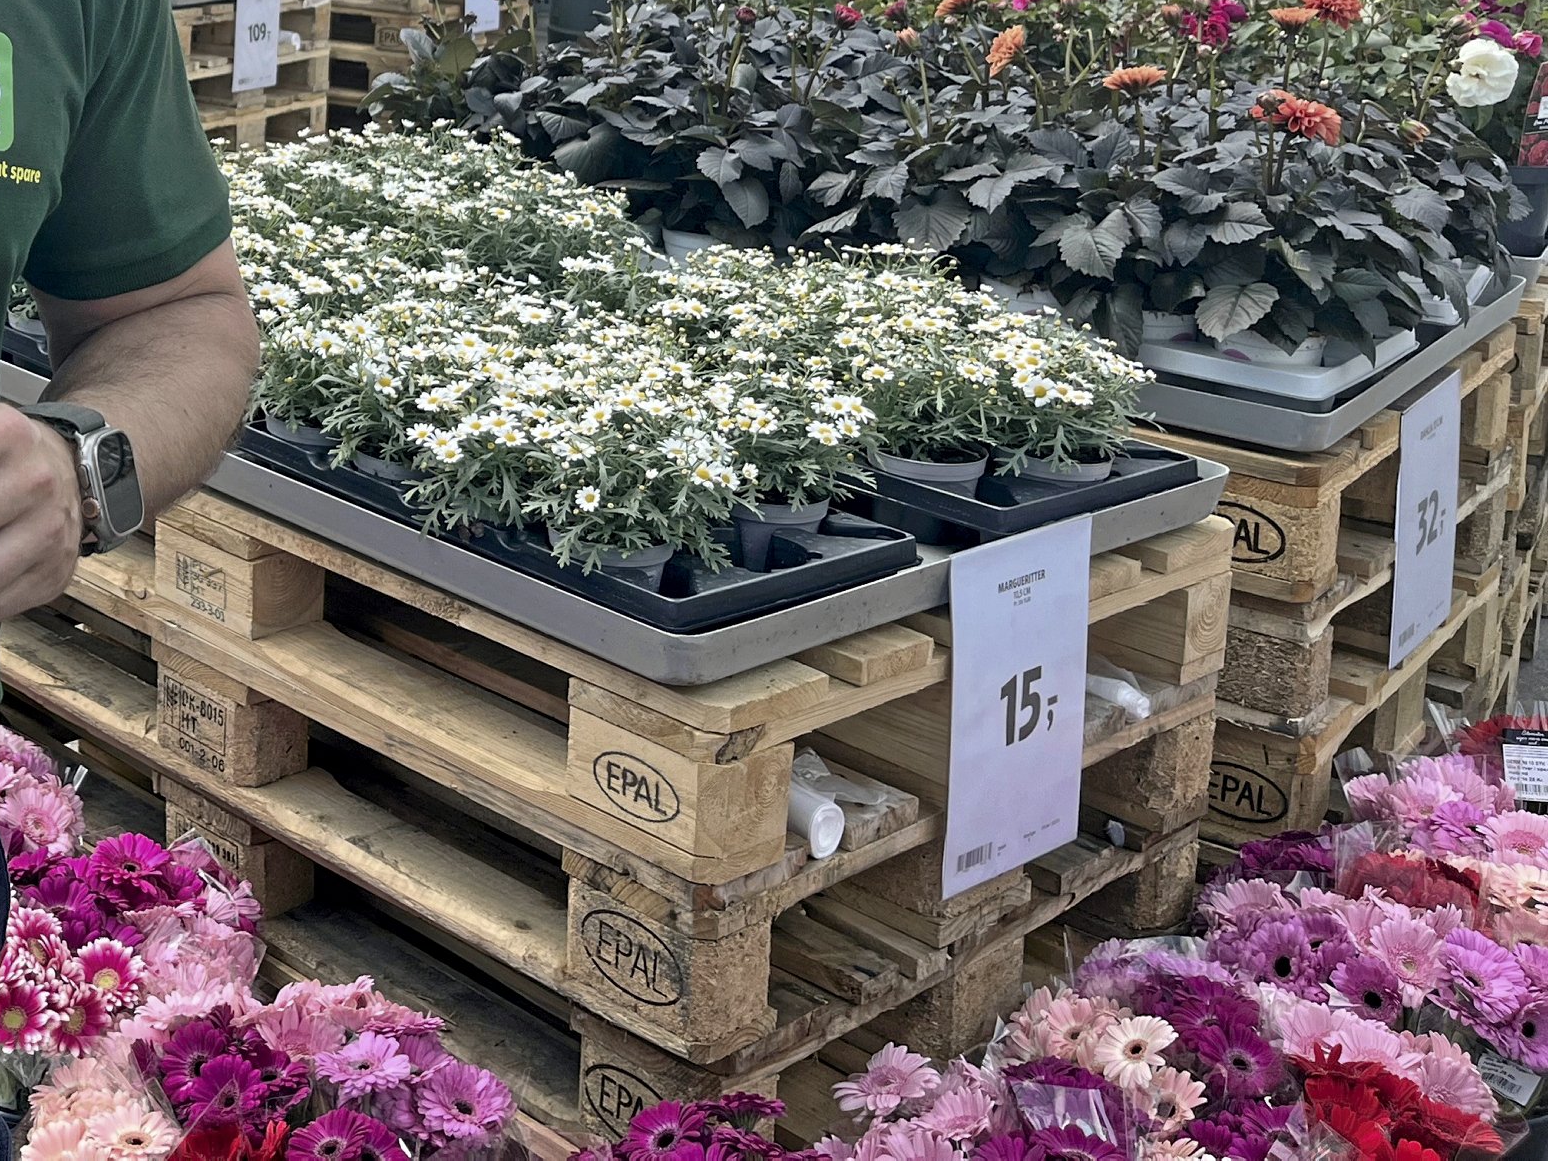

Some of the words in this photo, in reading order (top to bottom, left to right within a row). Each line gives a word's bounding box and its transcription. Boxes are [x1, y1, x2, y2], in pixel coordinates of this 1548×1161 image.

[10, 164, 41, 184] spare
[1233, 519, 1270, 555] AL
[998, 569, 1045, 593] MARGUERITTER
[182, 690, 223, 727] DK-8015
[182, 711, 197, 733] HT
[607, 760, 667, 816] EPAL
[596, 919, 668, 999] EPAL
[599, 1073, 644, 1120] EPA
